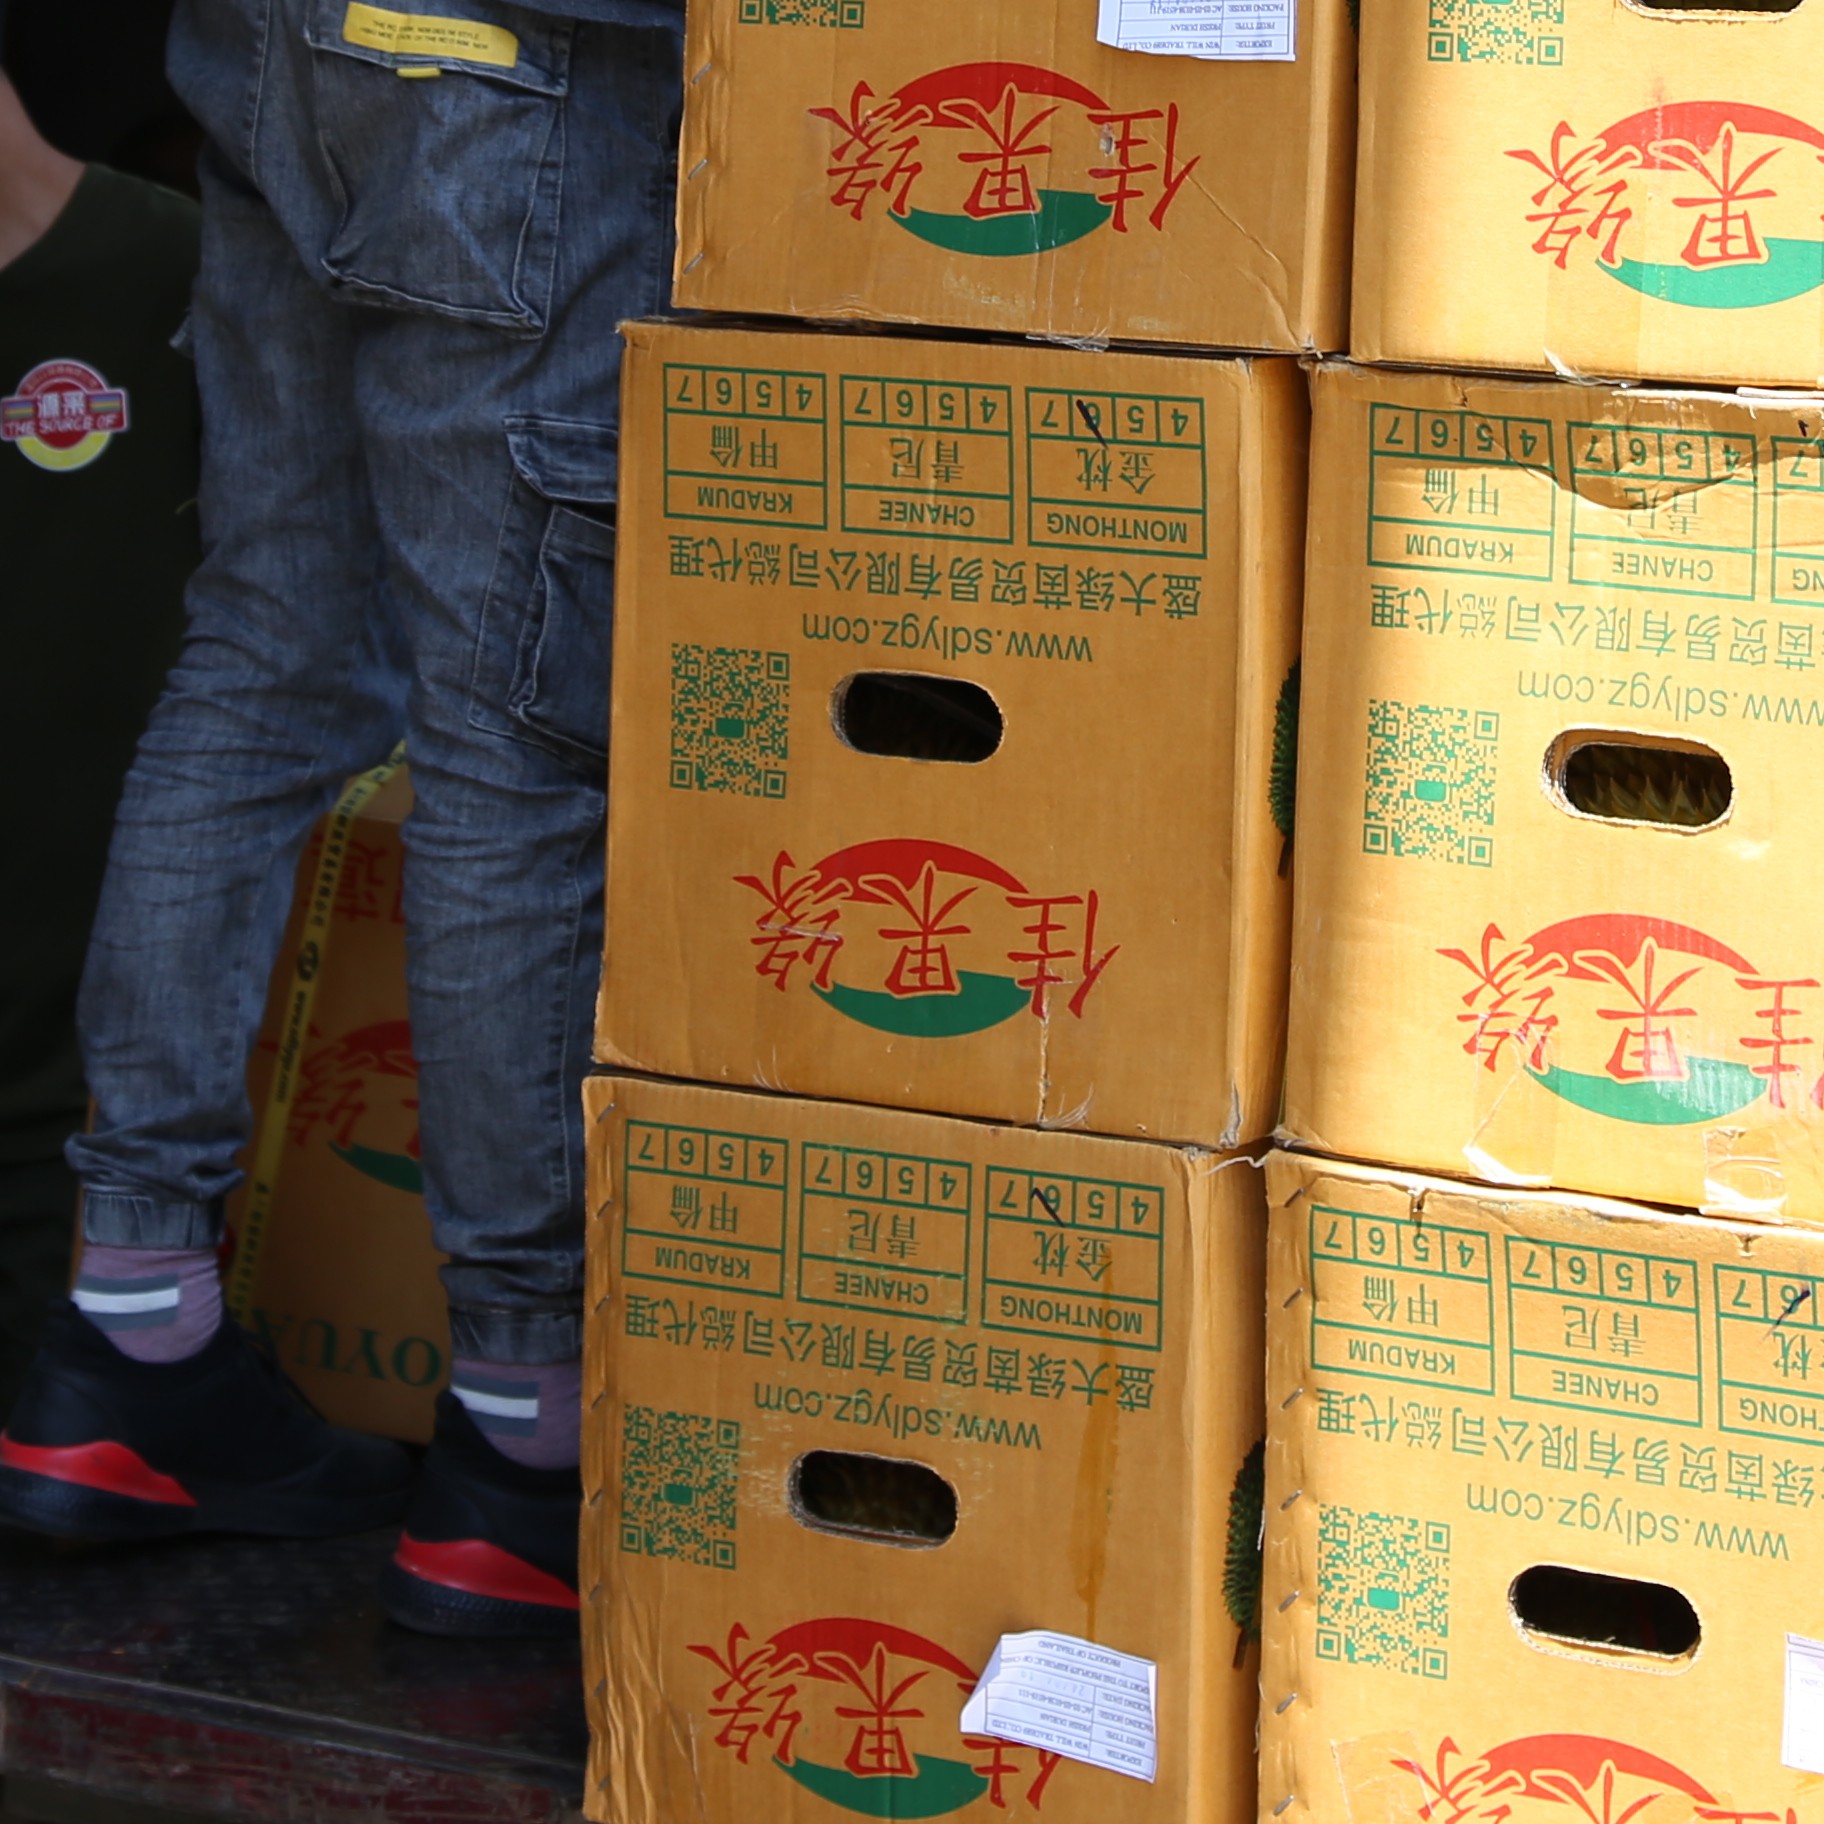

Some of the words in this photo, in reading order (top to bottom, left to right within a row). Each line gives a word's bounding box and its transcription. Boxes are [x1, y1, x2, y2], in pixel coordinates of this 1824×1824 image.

[807, 80, 1201, 233] 佳果缘
[888, 435, 965, 485] 青尼
[1075, 446, 1156, 497] 金枕
[697, 484, 793, 514] KRADUM
[879, 498, 975, 528] CHANEE
[1046, 510, 1189, 544] MONTHONG
[1404, 531, 1515, 564] KRADUM
[1609, 550, 1715, 583] CHANEE
[802, 610, 1093, 665] www.sdlygz.com
[732, 849, 1119, 1019] 佳果缘
[845, 1206, 922, 1261] 青尼
[1031, 1228, 1114, 1286] 金枕
[654, 1244, 751, 1280] KRADUM
[834, 1270, 929, 1306] CHANEE
[999, 1292, 1144, 1336] MONTHONG
[1560, 1302, 1647, 1361] 青尼
[1347, 1336, 1457, 1376] KRADUM
[1551, 1367, 1660, 1407] CHANEE
[753, 1381, 1042, 1453] www.sdlygz.com
[1465, 1482, 1791, 1564] www.sdlygz.com
